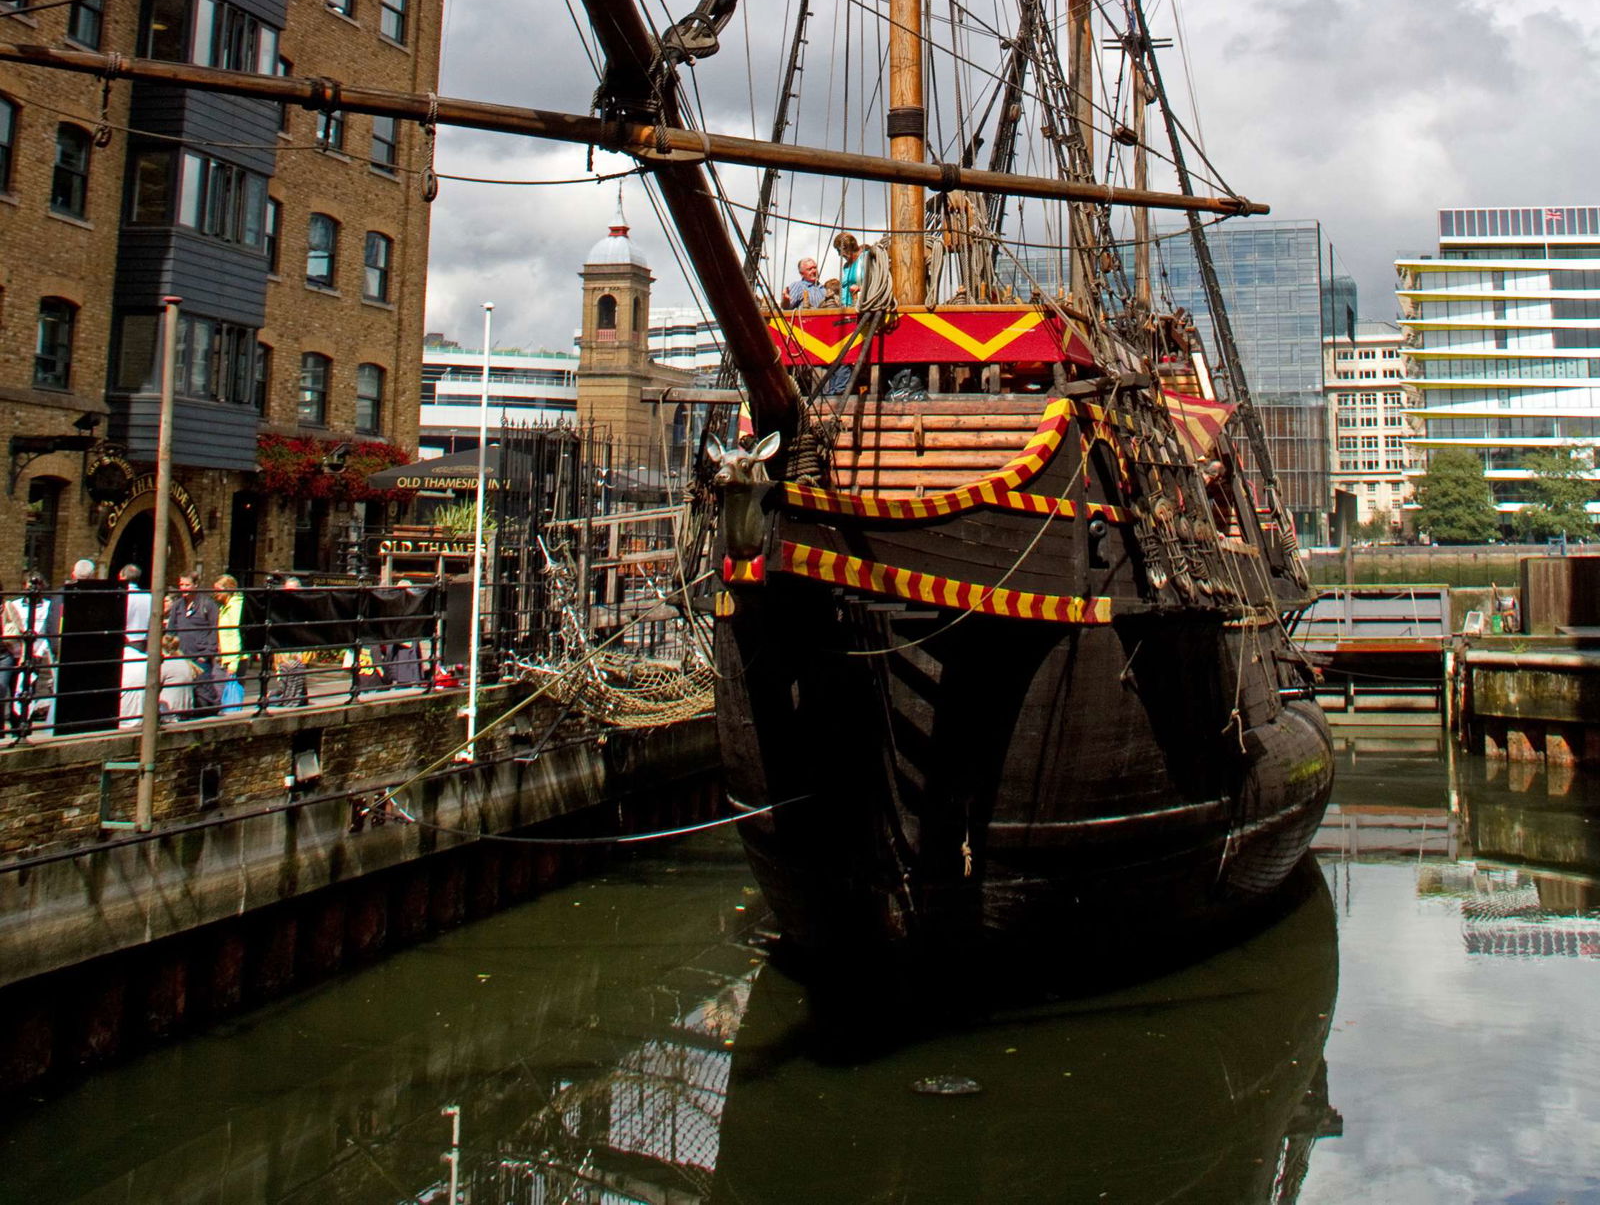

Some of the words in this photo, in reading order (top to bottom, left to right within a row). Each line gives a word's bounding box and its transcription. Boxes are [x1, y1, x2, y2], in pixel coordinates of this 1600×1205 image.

[397, 477, 420, 488] OLD
[424, 477, 483, 489] THAMESID
[107, 499, 128, 528] OL
[186, 504, 201, 533] INN
[380, 540, 412, 553] OLD
